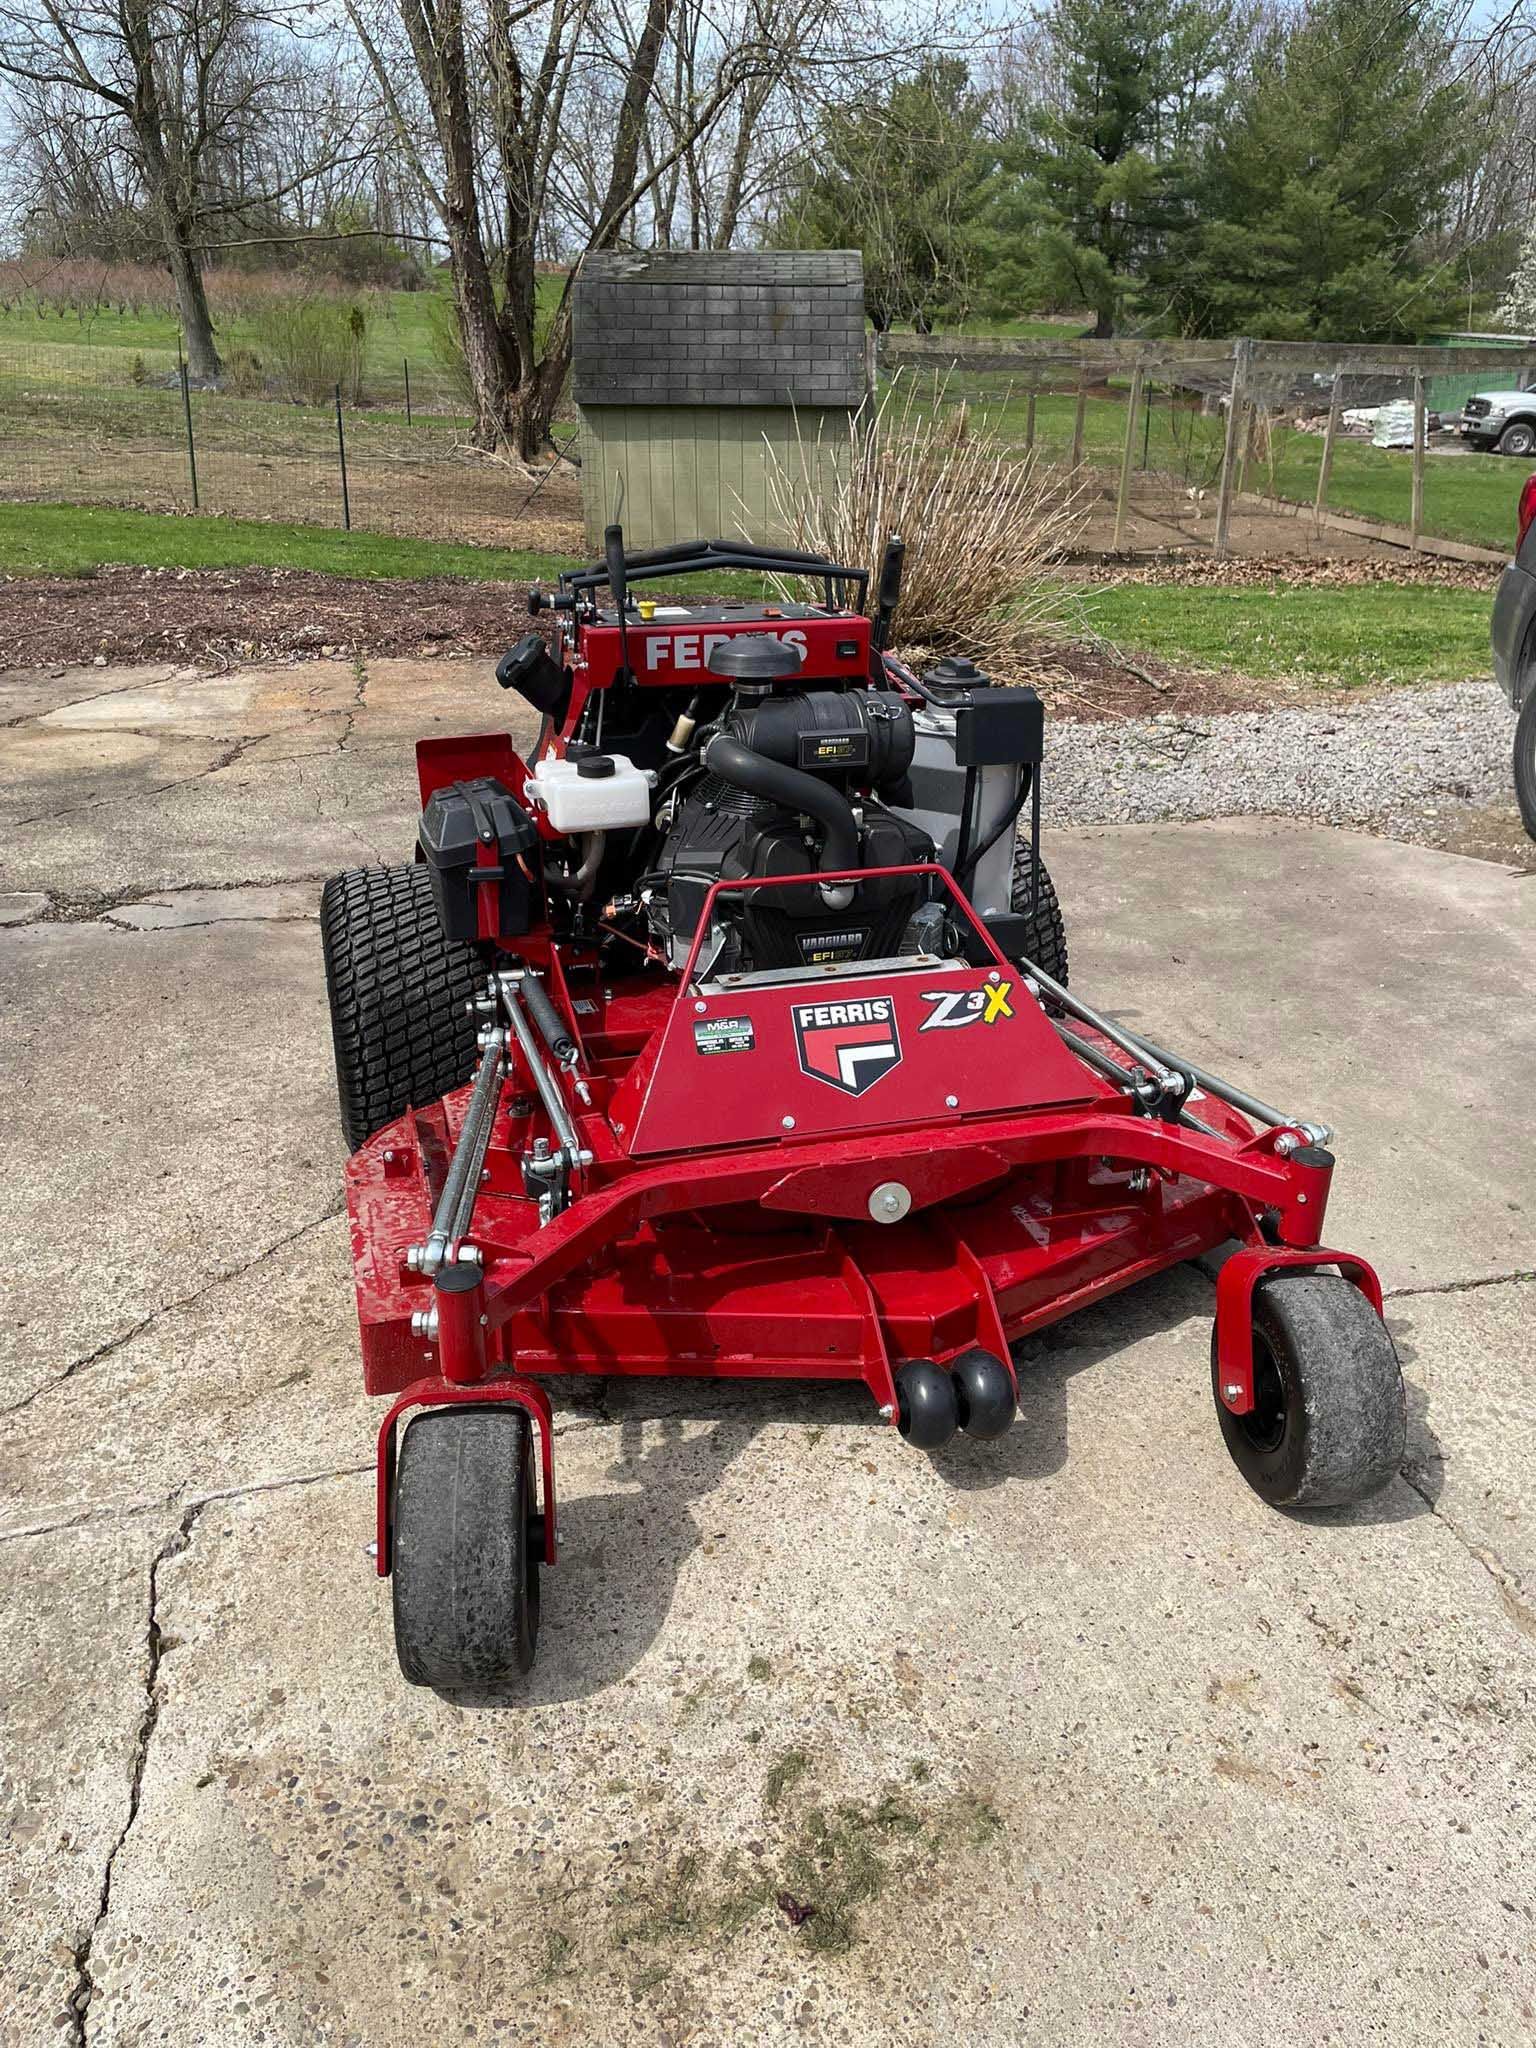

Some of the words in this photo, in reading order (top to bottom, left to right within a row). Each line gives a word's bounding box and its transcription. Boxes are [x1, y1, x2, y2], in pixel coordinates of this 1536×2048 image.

[646, 630, 808, 671] FES
[802, 933, 862, 950] VANGUARD
[800, 1001, 890, 1028] FERRIS
